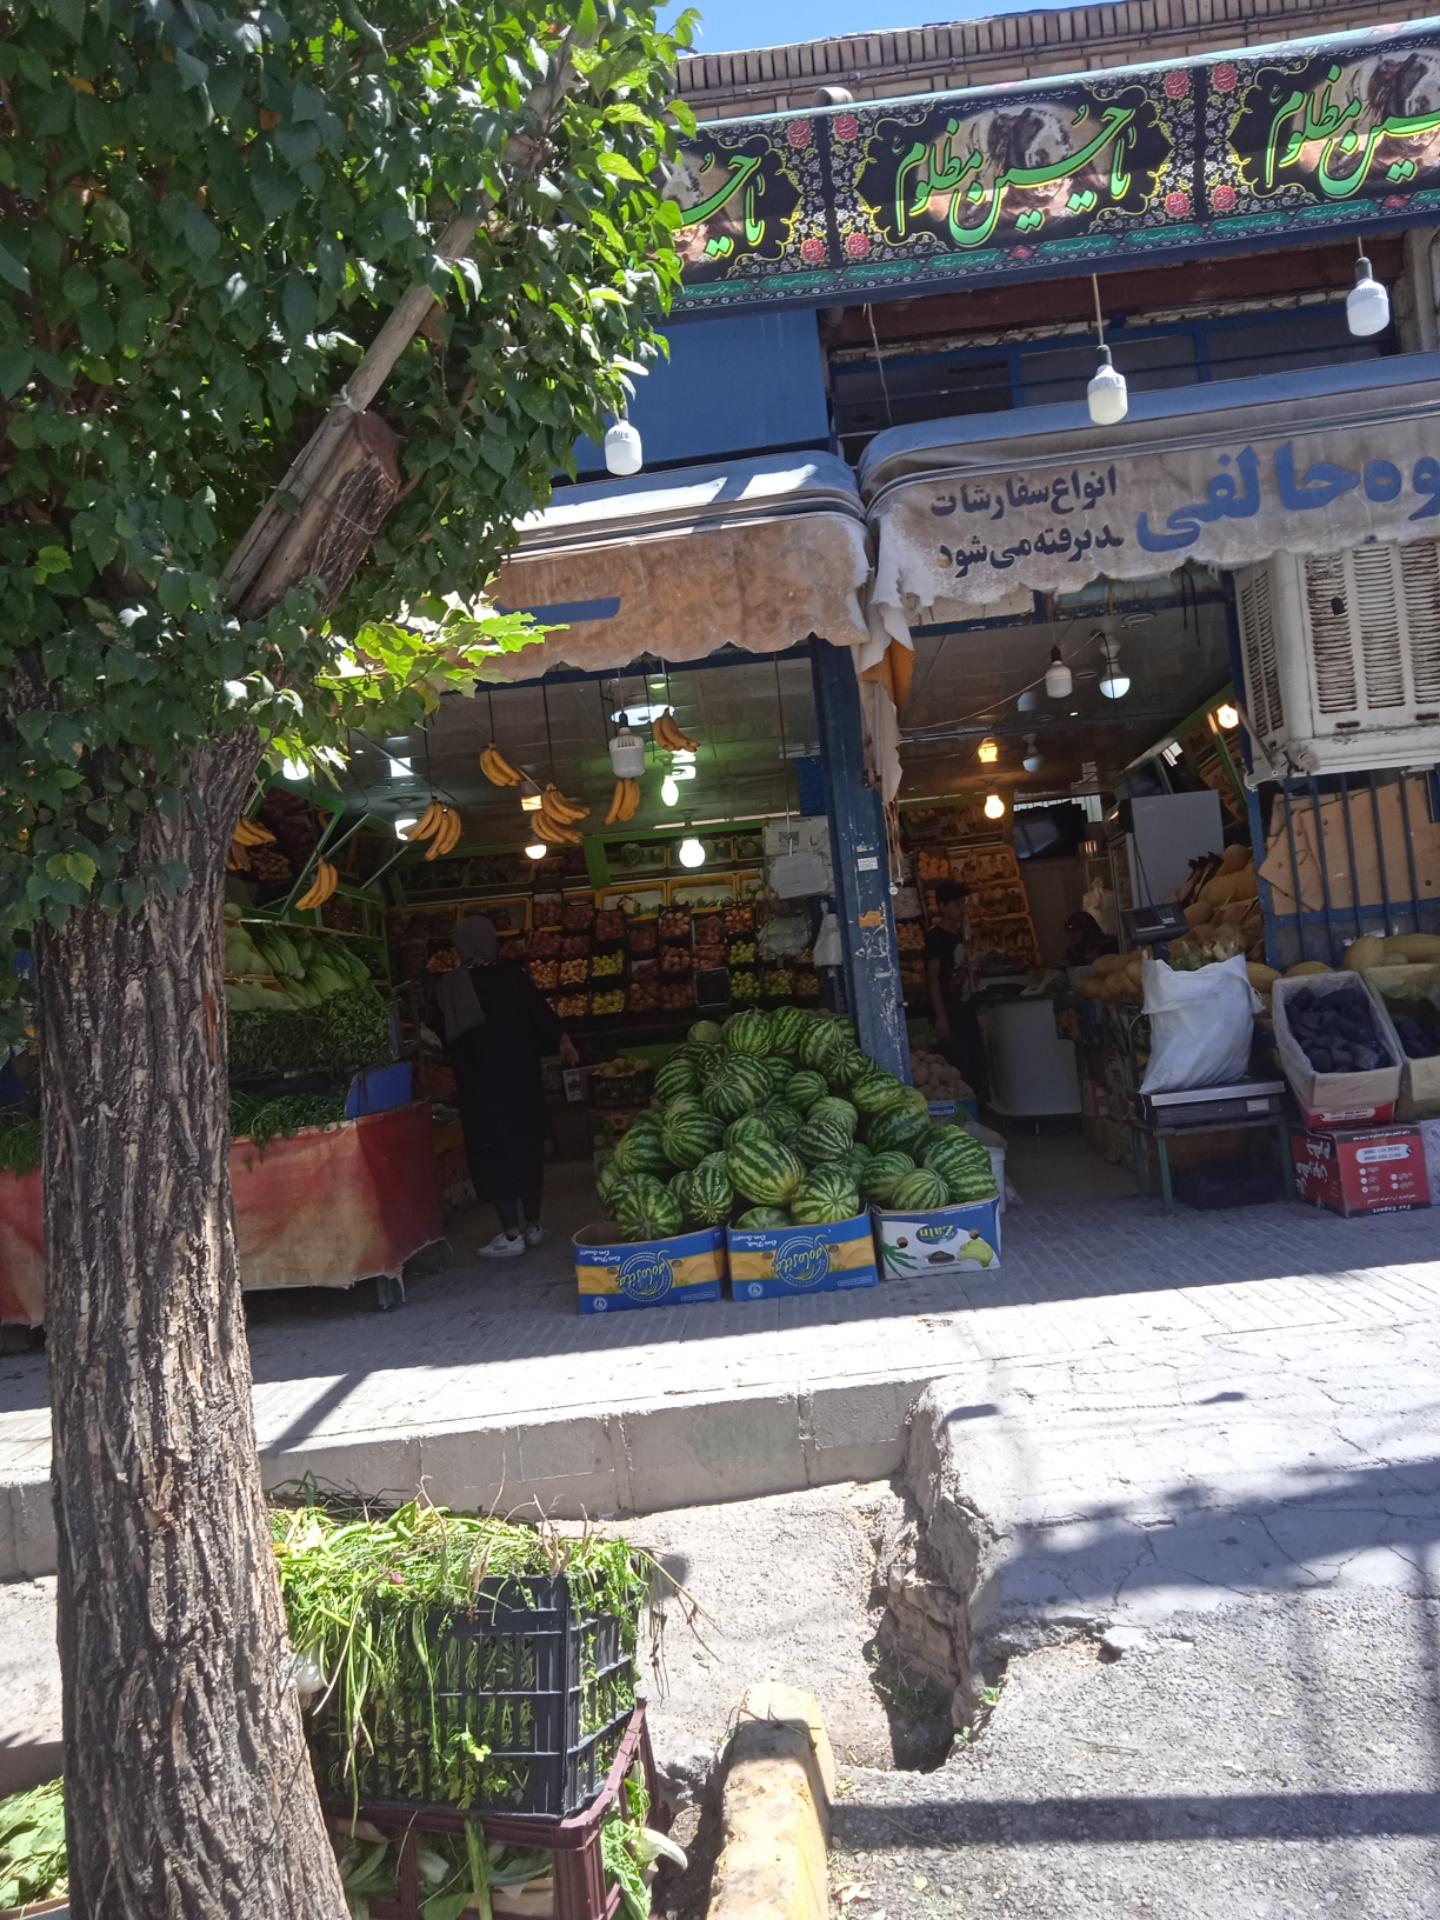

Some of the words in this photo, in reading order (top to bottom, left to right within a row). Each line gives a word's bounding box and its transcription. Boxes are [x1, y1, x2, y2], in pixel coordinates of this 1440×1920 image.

[895, 117, 985, 237] مظلوم
[949, 104, 1137, 247] حسین
[1265, 64, 1362, 189] مظلوم
[1318, 107, 1440, 199] سین
[930, 475, 1049, 520] سفارشات
[1051, 464, 1117, 515] انواع
